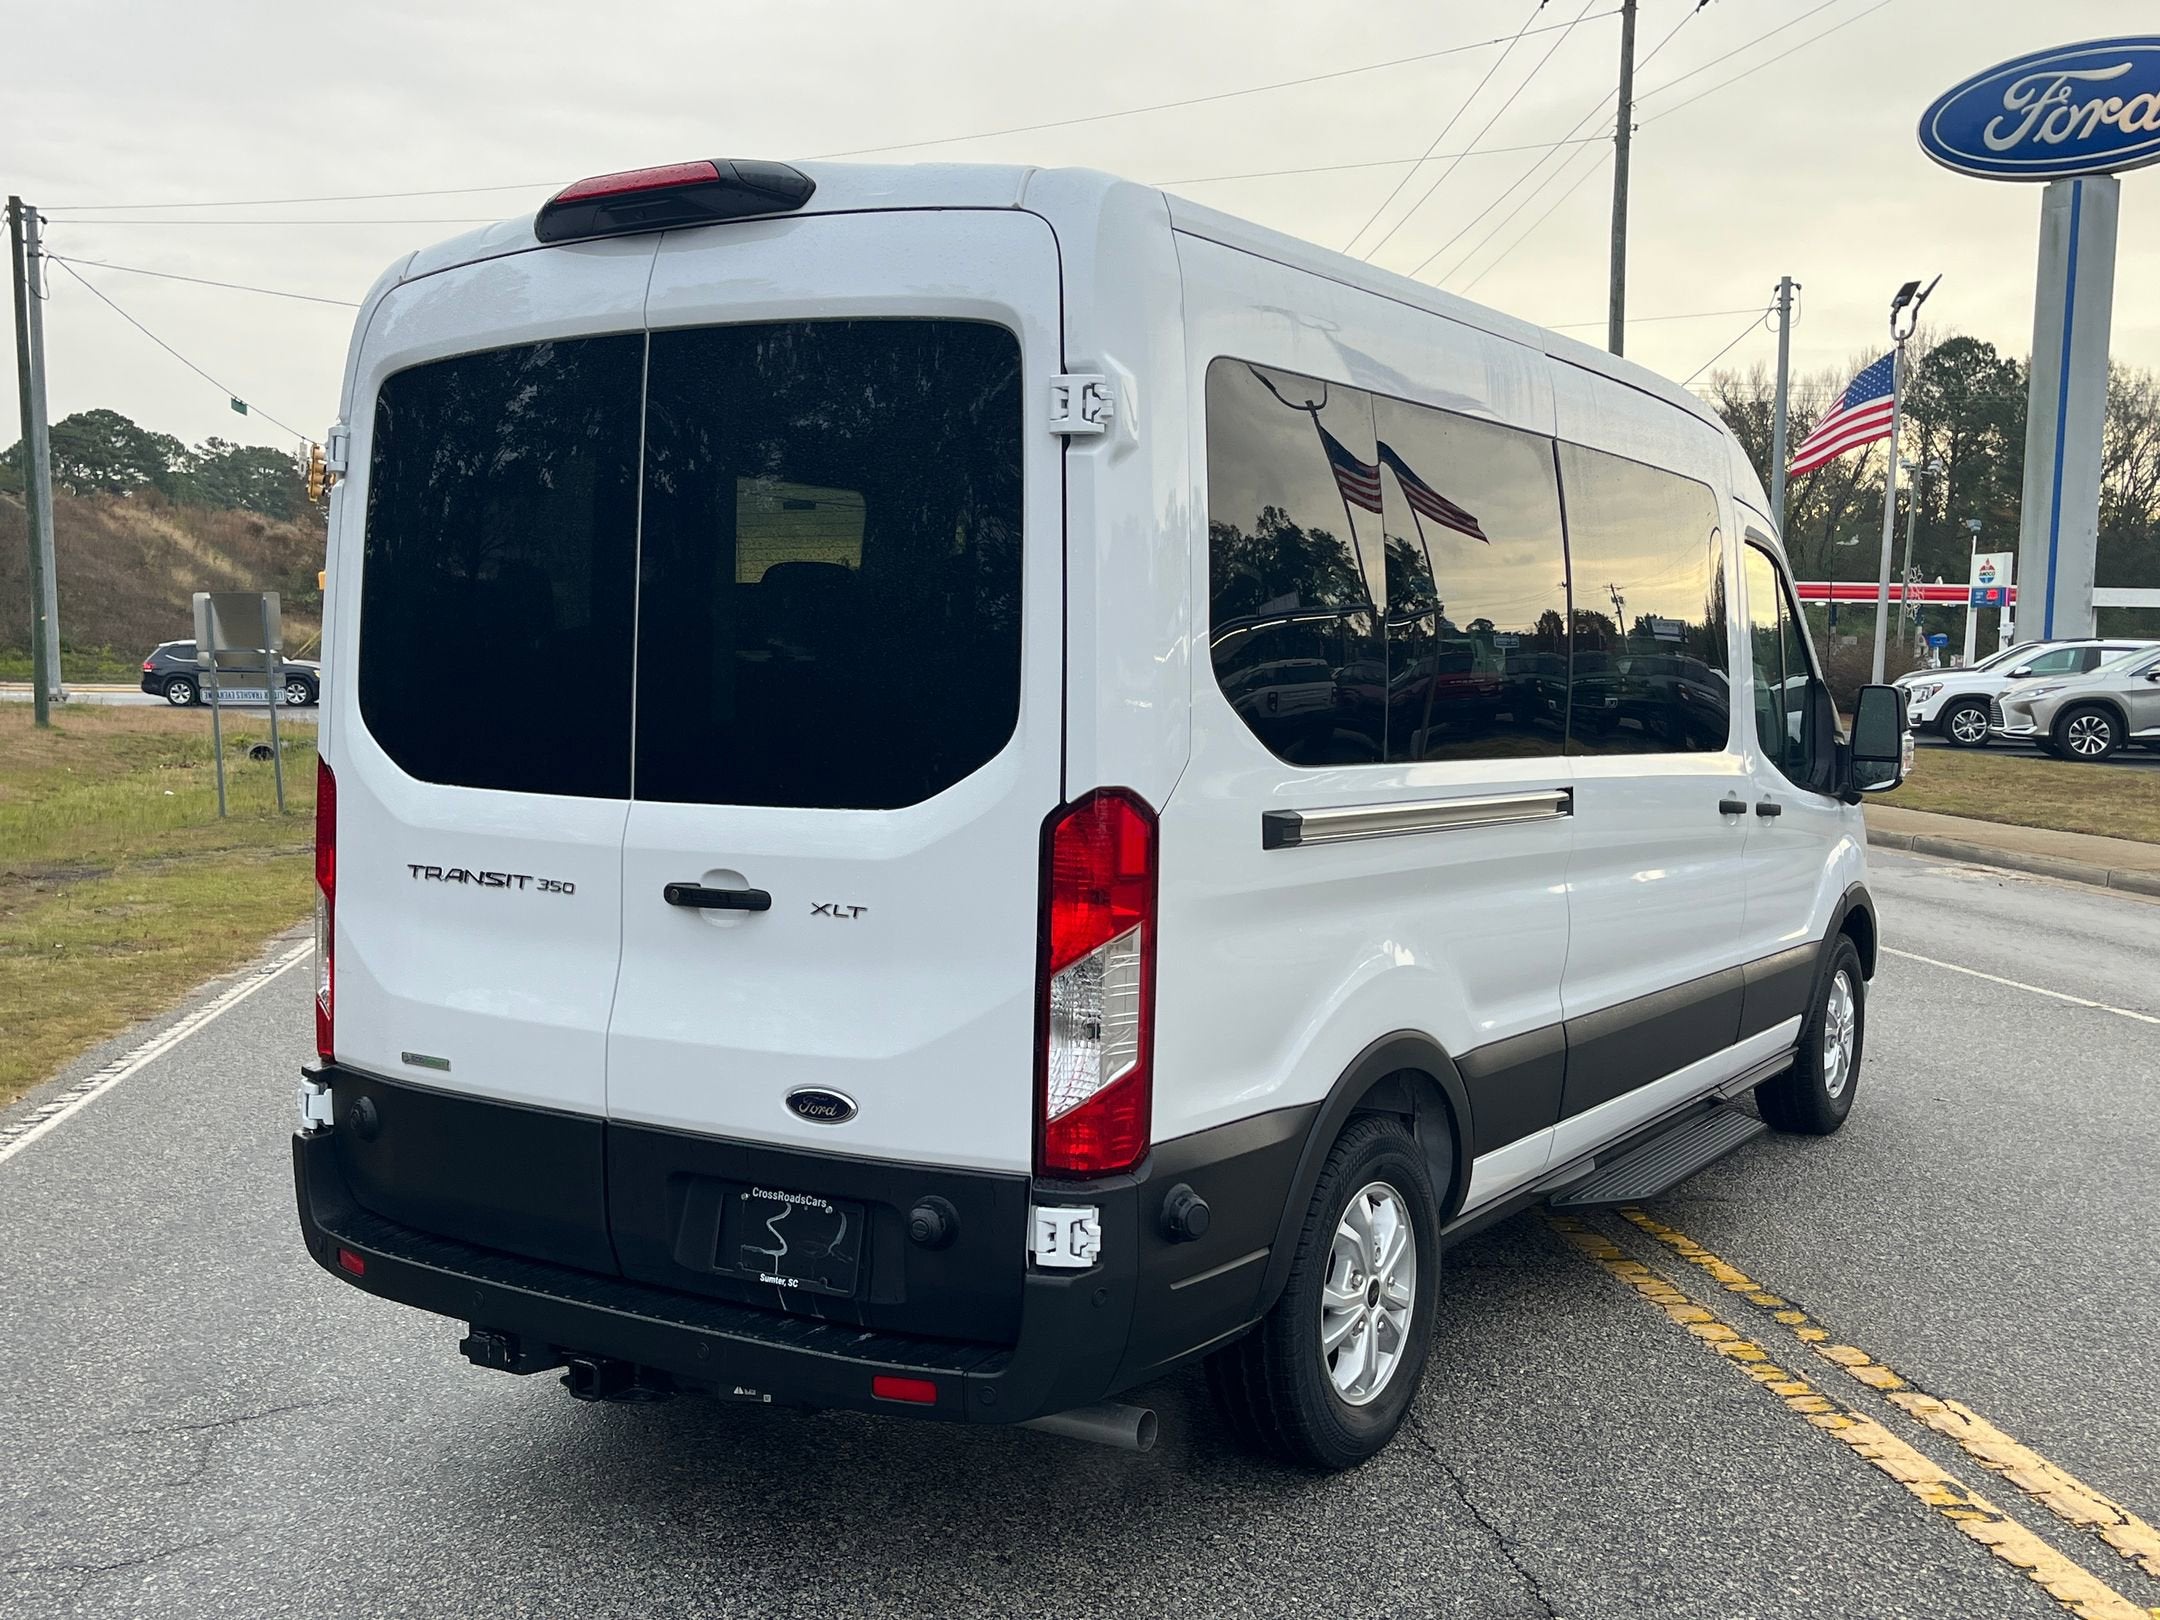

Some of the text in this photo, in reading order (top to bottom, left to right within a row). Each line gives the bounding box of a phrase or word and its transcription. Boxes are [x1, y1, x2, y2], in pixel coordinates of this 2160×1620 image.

[236, 691, 263, 700] TRASHES
[407, 864, 576, 895] TRANSIT 350
[810, 902, 868, 919] XLT
[798, 1095, 837, 1116] Ford
[752, 1187, 827, 1208] CrossRoadsCars
[760, 1273, 799, 1288] Sumter, SC
